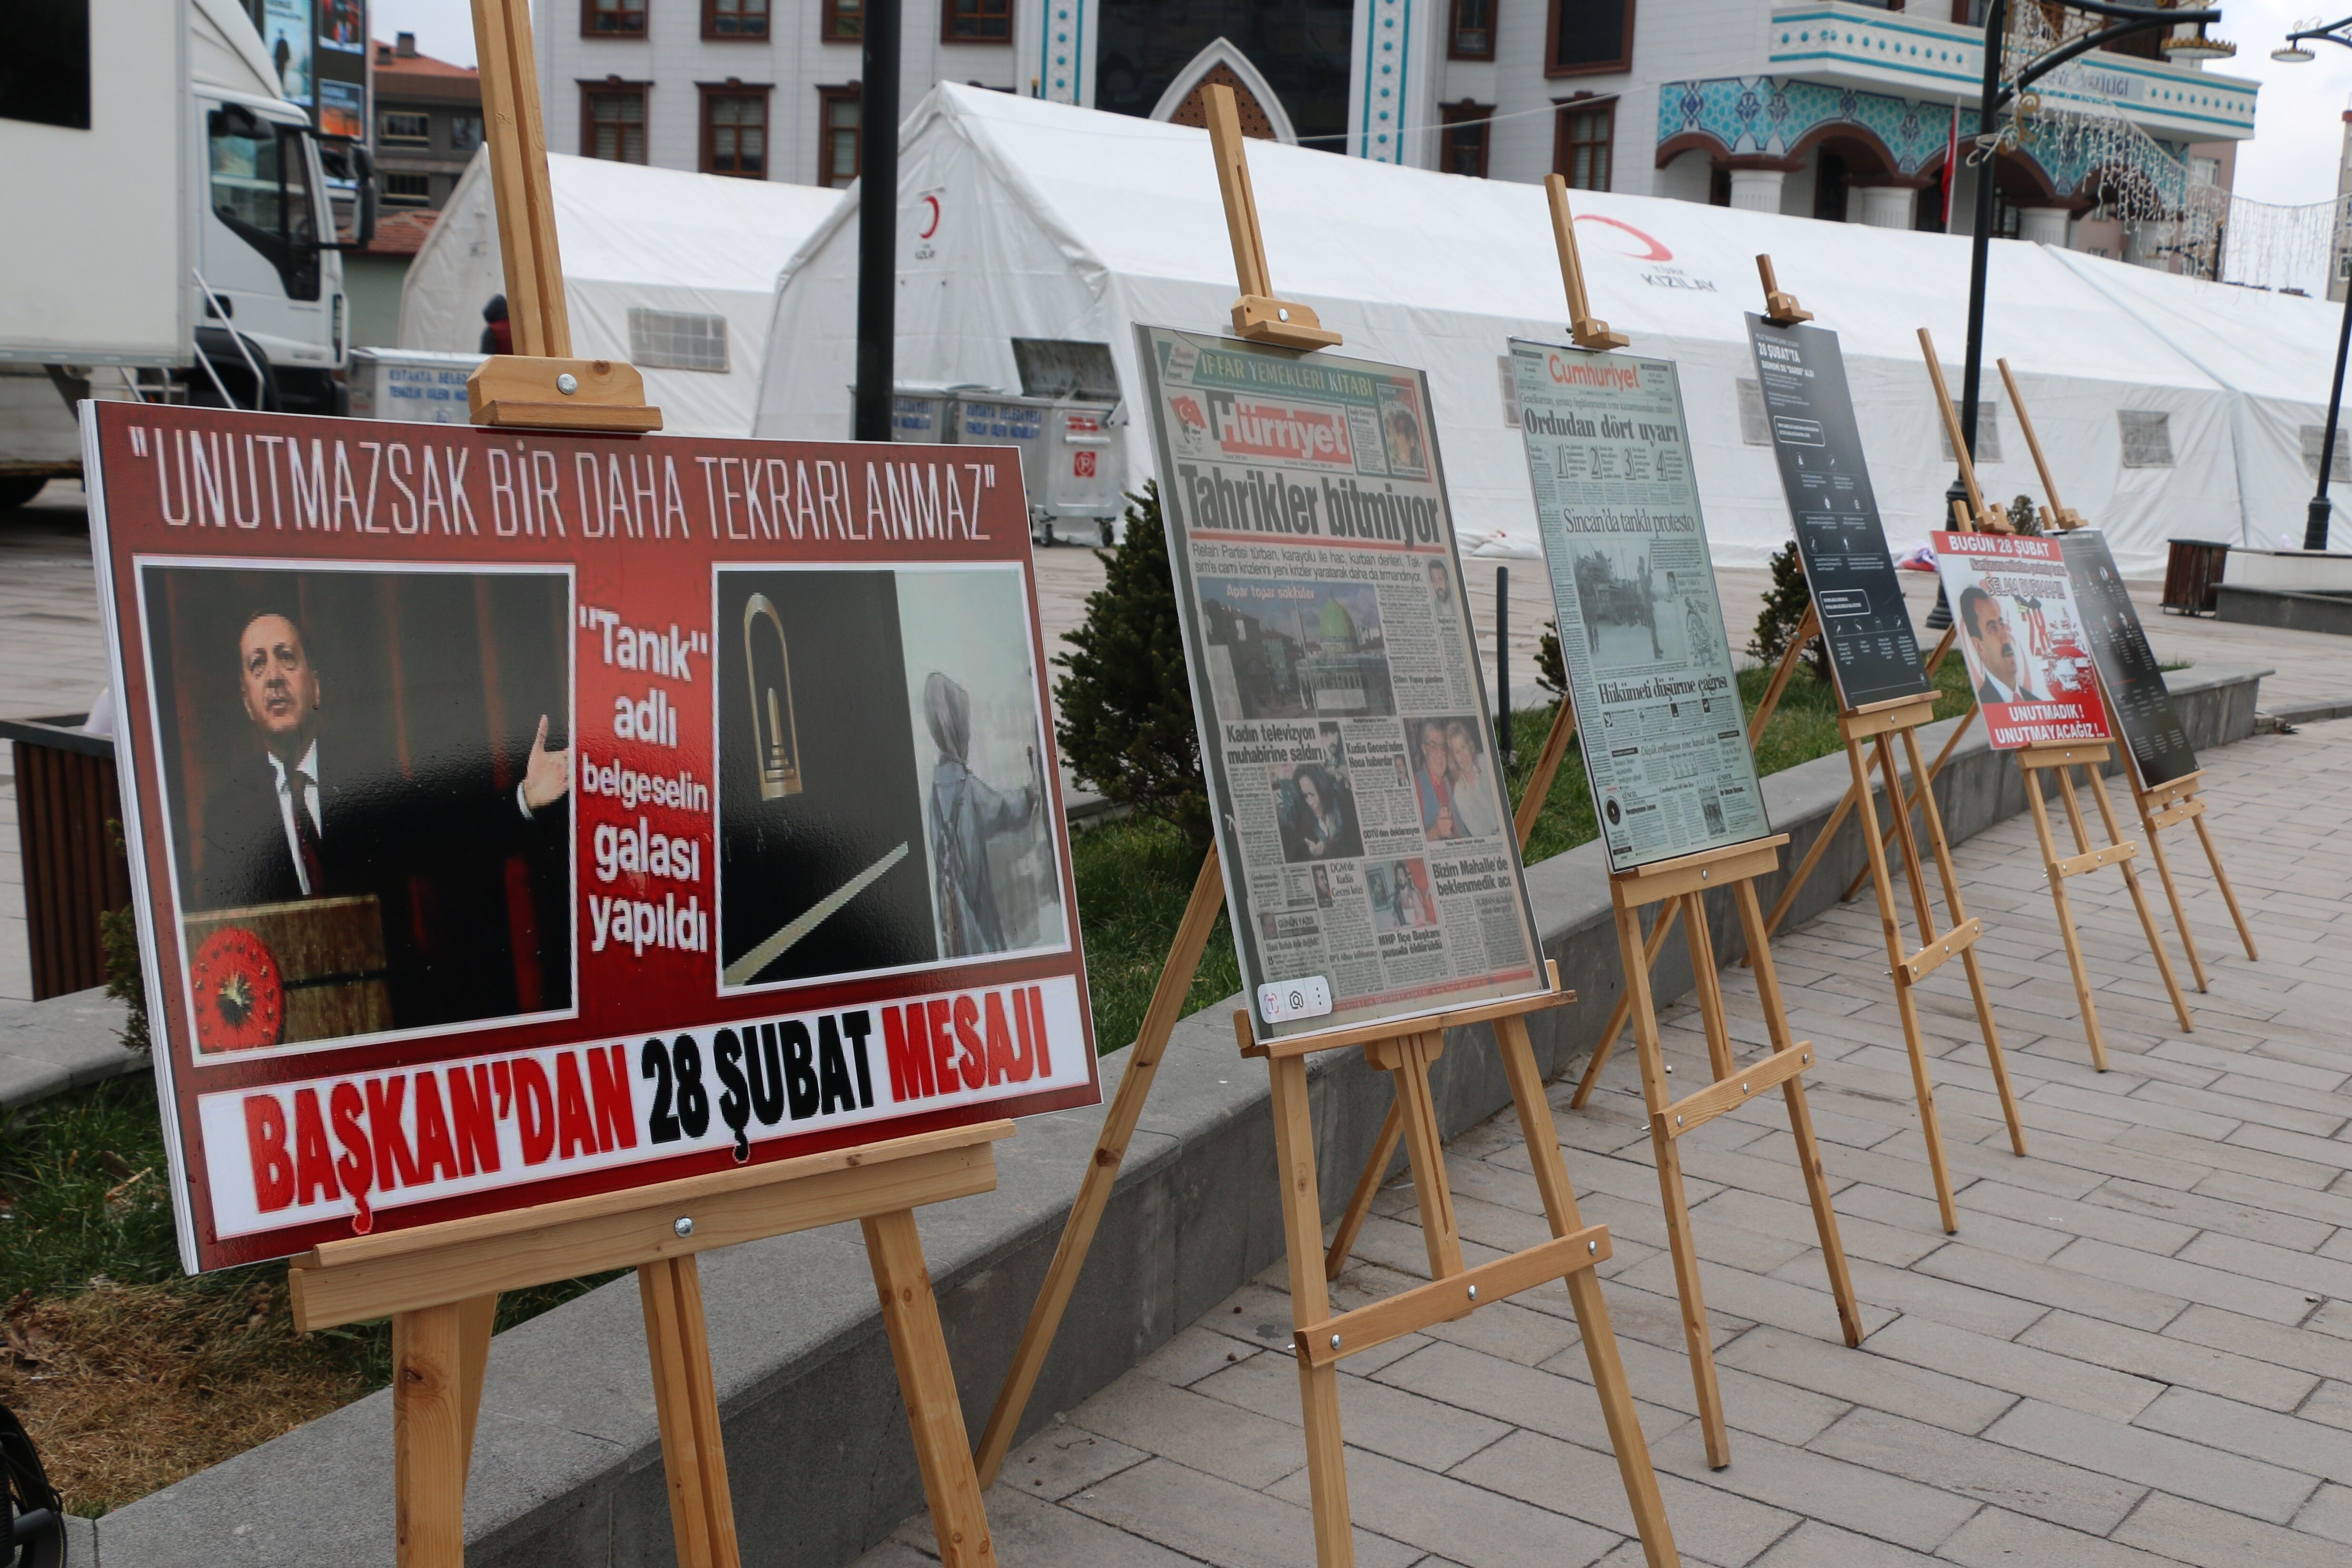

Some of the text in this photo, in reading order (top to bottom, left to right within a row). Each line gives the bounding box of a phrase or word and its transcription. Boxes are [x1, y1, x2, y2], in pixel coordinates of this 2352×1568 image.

[1640, 273, 1718, 292] KIZILAY
[1758, 342, 1767, 356] 28
[1248, 357, 1325, 390] YEMEKLERİ
[1326, 368, 1373, 396] KİTABI
[1549, 354, 1640, 392] Cumhuriyet
[1216, 400, 1347, 458] Hürriyet
[1524, 408, 1680, 447] Ordudan dört uyarı
[1557, 445, 1565, 475] 1
[1590, 446, 1599, 475] 2
[1624, 447, 1633, 476] 3
[1656, 448, 1665, 477] 4
[128, 425, 995, 541] "UNUTMAZSAK BİR DAHA TEKRARLANMAZ"
[1179, 464, 1442, 551] Tahrikler bitmiyor
[1563, 507, 1695, 537] Sincan'da tanklı protesto
[1191, 543, 1423, 568] Refah Partisi türban, karayolu ile hac, kurban derileri, Tak-
[1948, 531, 2049, 558] BUGÜN 28 ŞUBAT
[1194, 559, 1217, 572] sim'e
[1217, 560, 1238, 574] cami
[1239, 561, 1271, 575] krizlerini
[1272, 563, 1290, 578] yeni
[1289, 564, 1312, 577] krizler
[1312, 565, 1348, 581] yaratarak
[1348, 567, 1368, 579] daha
[1367, 568, 1379, 580] da
[1225, 584, 1249, 598] Apar
[1251, 585, 1276, 599] topar
[1986, 577, 2019, 597] SELAM
[579, 604, 708, 682] "Tanık"
[1598, 672, 1729, 705] Hükümeti düşürme çağrısı
[613, 687, 677, 749] adlı
[2008, 704, 2079, 722] UNUTMADIK
[1225, 723, 1316, 745] Kadın televizyon
[1995, 720, 2095, 744] UNUTMAYACAĞIZ
[1226, 744, 1322, 764] muhabirine saldırı
[1345, 742, 1367, 754] Kudüs
[1348, 755, 1393, 768] Hoca haberdar
[582, 752, 709, 813] belgeselin
[593, 815, 701, 884] galası
[1431, 856, 1509, 879] Bizim Mahalle'de
[1435, 874, 1512, 896] beklenmedik acı
[588, 891, 708, 957] yapıldı
[1378, 926, 1441, 945] MHP İlçe Başkanı
[1381, 939, 1443, 960] pusuda öldürüldü
[242, 985, 1052, 1235] BAŞKAN'DAN 28 ŞUBAT MESAJI
